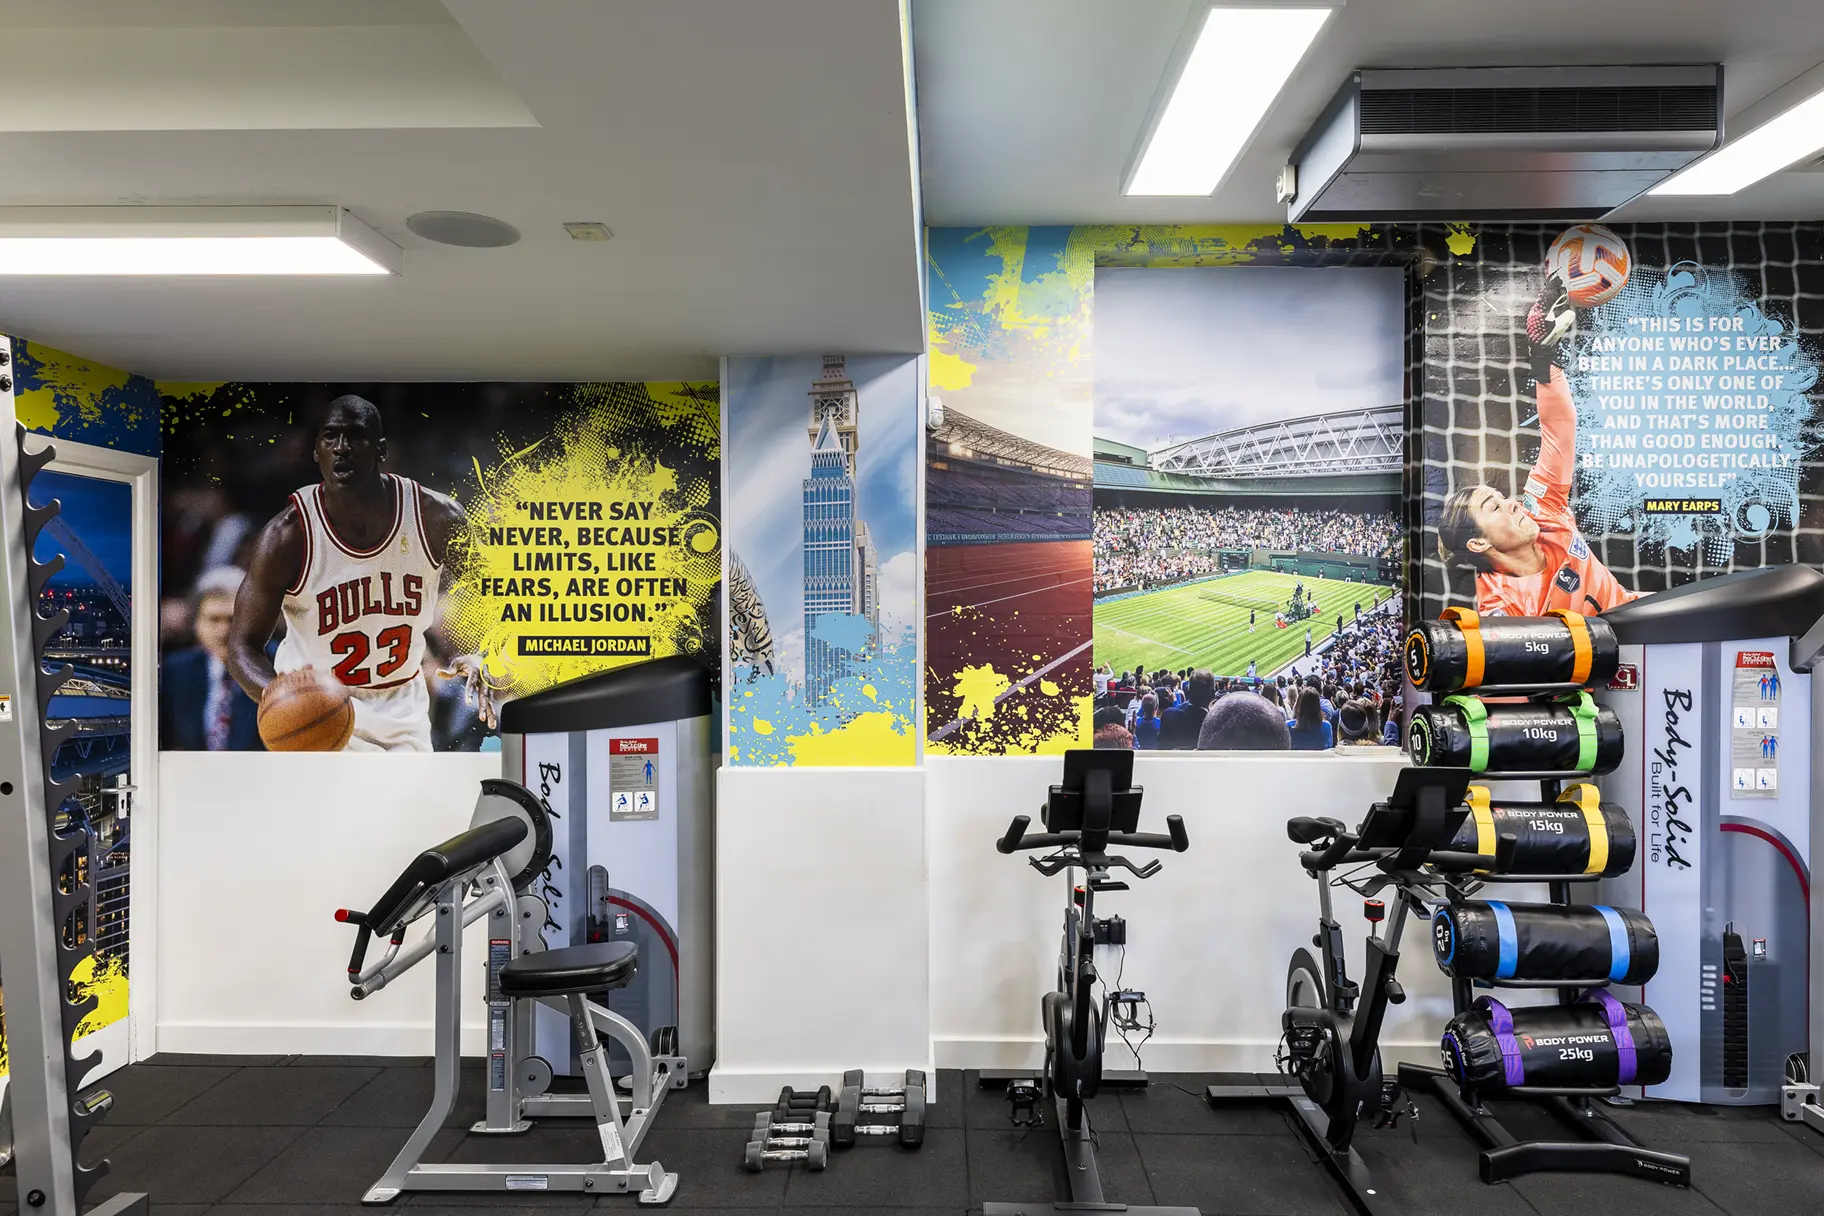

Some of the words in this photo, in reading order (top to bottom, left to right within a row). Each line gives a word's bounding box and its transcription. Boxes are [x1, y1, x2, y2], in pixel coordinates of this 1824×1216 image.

[1627, 317, 1681, 332] “THIS
[1686, 317, 1704, 332] IS
[1709, 317, 1743, 332] FOR
[1591, 337, 1664, 351] ANYONE
[1669, 337, 1731, 351] WHO’S
[1736, 337, 1781, 351] EVER
[1579, 356, 1623, 371] BEEN
[1629, 356, 1647, 371] IN
[1652, 356, 1664, 371] A
[1670, 356, 1719, 371] DARK
[1724, 356, 1794, 371] PLACE...
[1591, 376, 1663, 391] THERE’S
[1668, 376, 1714, 391] ONLY
[1719, 376, 1756, 391] ONE
[1761, 376, 1784, 391] OF
[1599, 395, 1636, 410] YOU
[1641, 395, 1659, 410] IN
[1664, 395, 1697, 410] THE
[1702, 395, 1774, 413] WORLD,
[1604, 414, 1641, 429] AND
[1646, 414, 1709, 429] THAT’S
[1715, 414, 1769, 429] MORE
[1590, 434, 1637, 449] THAN
[1642, 434, 1695, 449] GOOD
[1701, 434, 1783, 449] ENOUGH.
[1582, 453, 1604, 468] BE
[1609, 453, 1791, 468] UNAPOLOGETICALLY
[1635, 472, 1737, 488] YOURSELF”
[516, 502, 602, 520] “NEVER
[609, 502, 653, 520] SAY
[1646, 501, 1680, 512] MARY
[1682, 501, 1719, 512] EARPS
[489, 527, 570, 549] NEVER,
[577, 527, 681, 546] BECAUSE
[513, 552, 600, 574] LIMITS,
[607, 553, 656, 571] LIKE
[481, 578, 559, 599] FEARS,
[565, 578, 609, 596] ARE
[616, 578, 687, 596] OFTEN
[316, 571, 423, 636] BULLS
[500, 603, 532, 622] AN
[539, 603, 667, 622] ILLUSION.”
[525, 639, 588, 652] MICHAEL
[590, 639, 647, 653] JORDAN
[1525, 641, 1549, 654] 5kg
[330, 624, 412, 686] 23
[1410, 648, 1418, 667] 5
[1411, 734, 1421, 750] 10
[1522, 727, 1557, 742] 10kg
[1651, 762, 1662, 798] Built
[1654, 688, 1692, 868] Body-Solid
[1507, 810, 1537, 818] BODY
[1538, 811, 1579, 819] POWER
[1651, 804, 1662, 827] for
[1529, 820, 1564, 834] 15kg
[1651, 833, 1662, 863] Life
[1436, 925, 1445, 952] 20
[1444, 930, 1450, 942] kg
[1535, 1037, 1566, 1046] BODY
[1567, 1034, 1609, 1044] POWER
[1441, 1049, 1454, 1069] 25
[1558, 1047, 1593, 1061] 25kg
[1659, 1166, 1680, 1175] POWER
